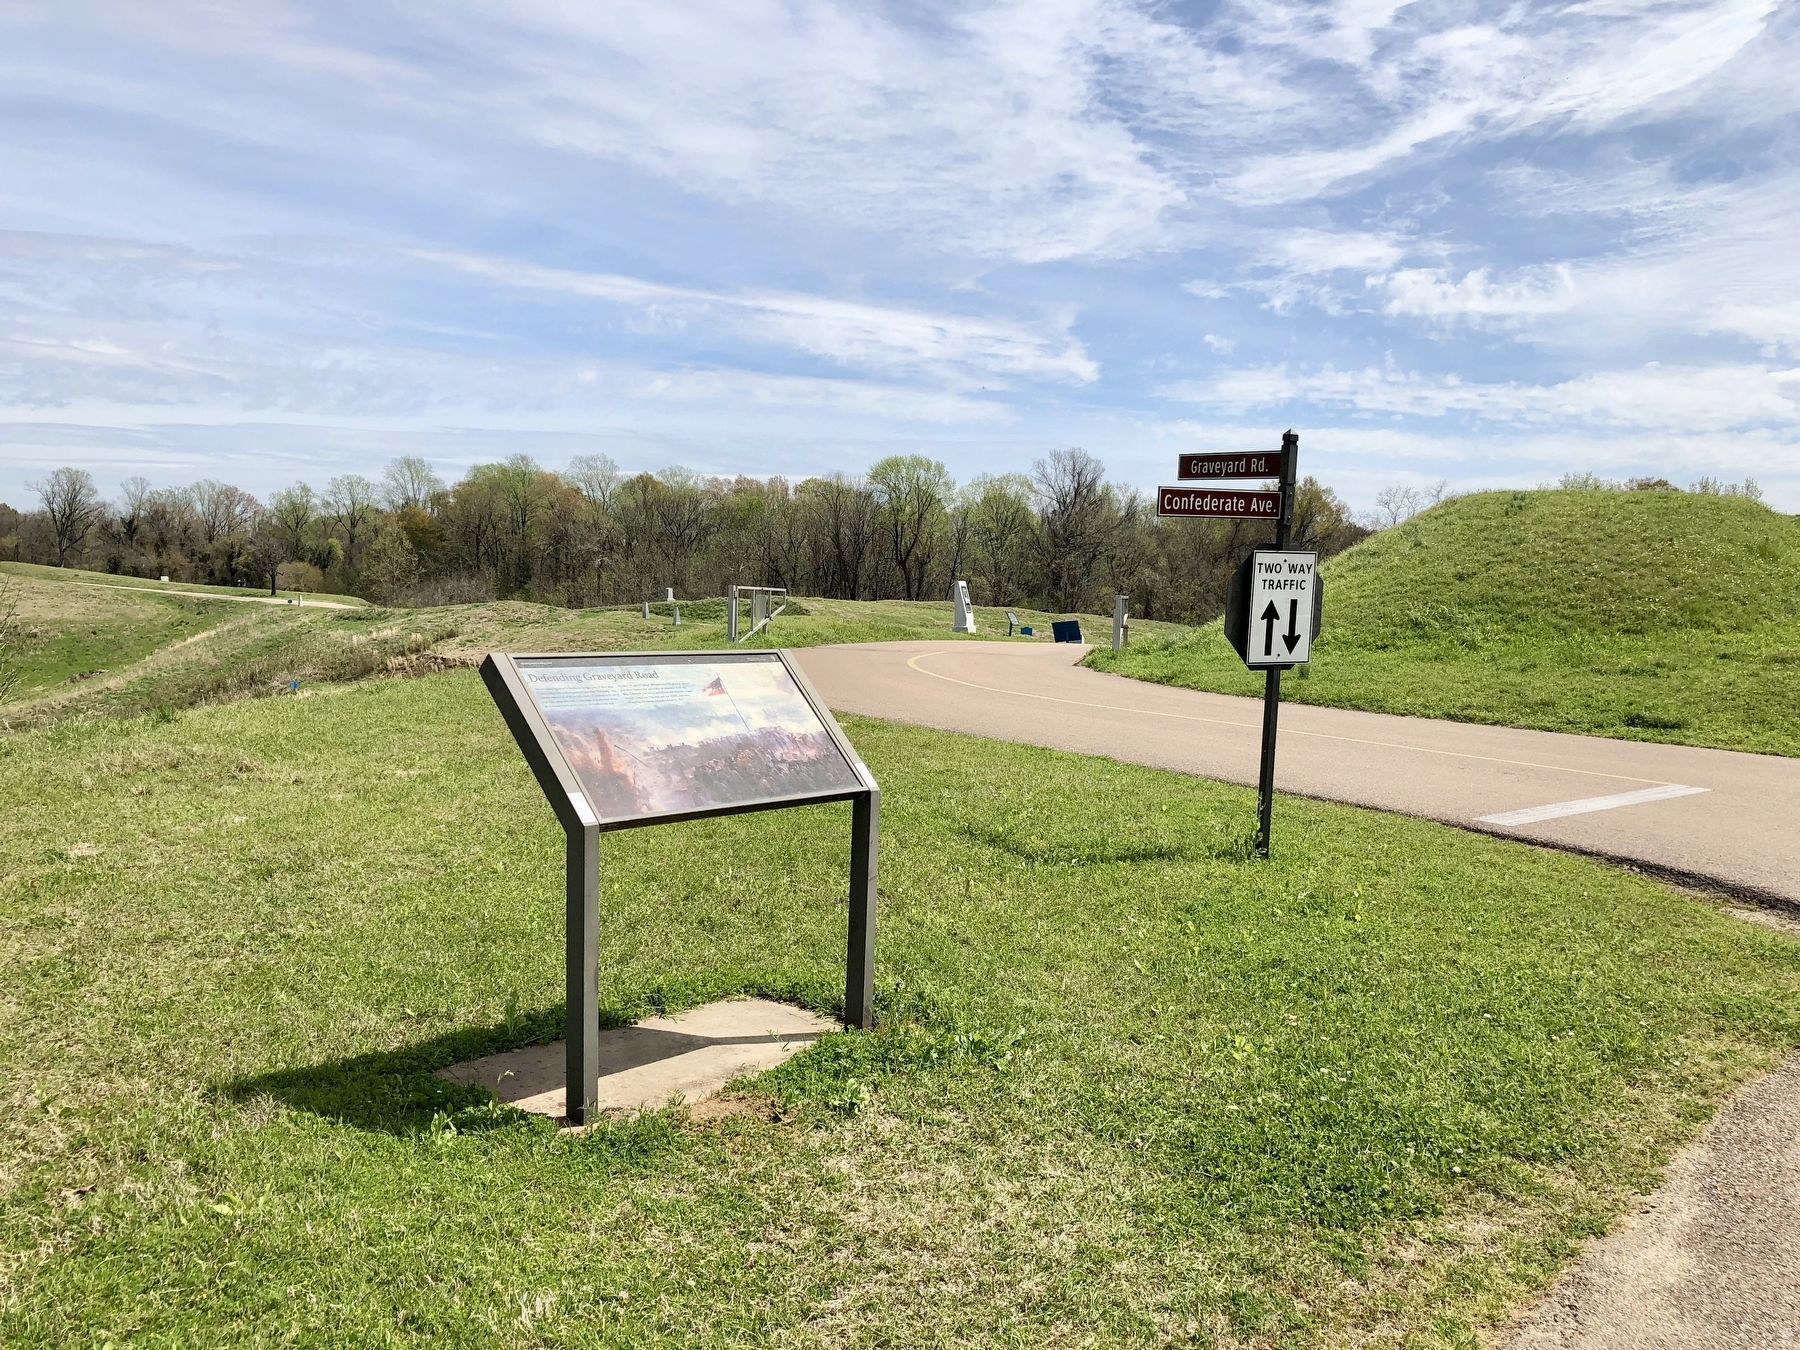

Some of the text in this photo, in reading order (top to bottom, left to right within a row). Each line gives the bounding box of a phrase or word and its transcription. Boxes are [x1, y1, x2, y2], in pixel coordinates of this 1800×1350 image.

[1191, 457, 1269, 476] Graveyard Rd.
[1164, 494, 1277, 513] Confederate Ave.
[1257, 563, 1313, 574] TWO WAY
[1262, 579, 1306, 590] TRAFFIC
[528, 670, 660, 683] Defending Graveyard Road
